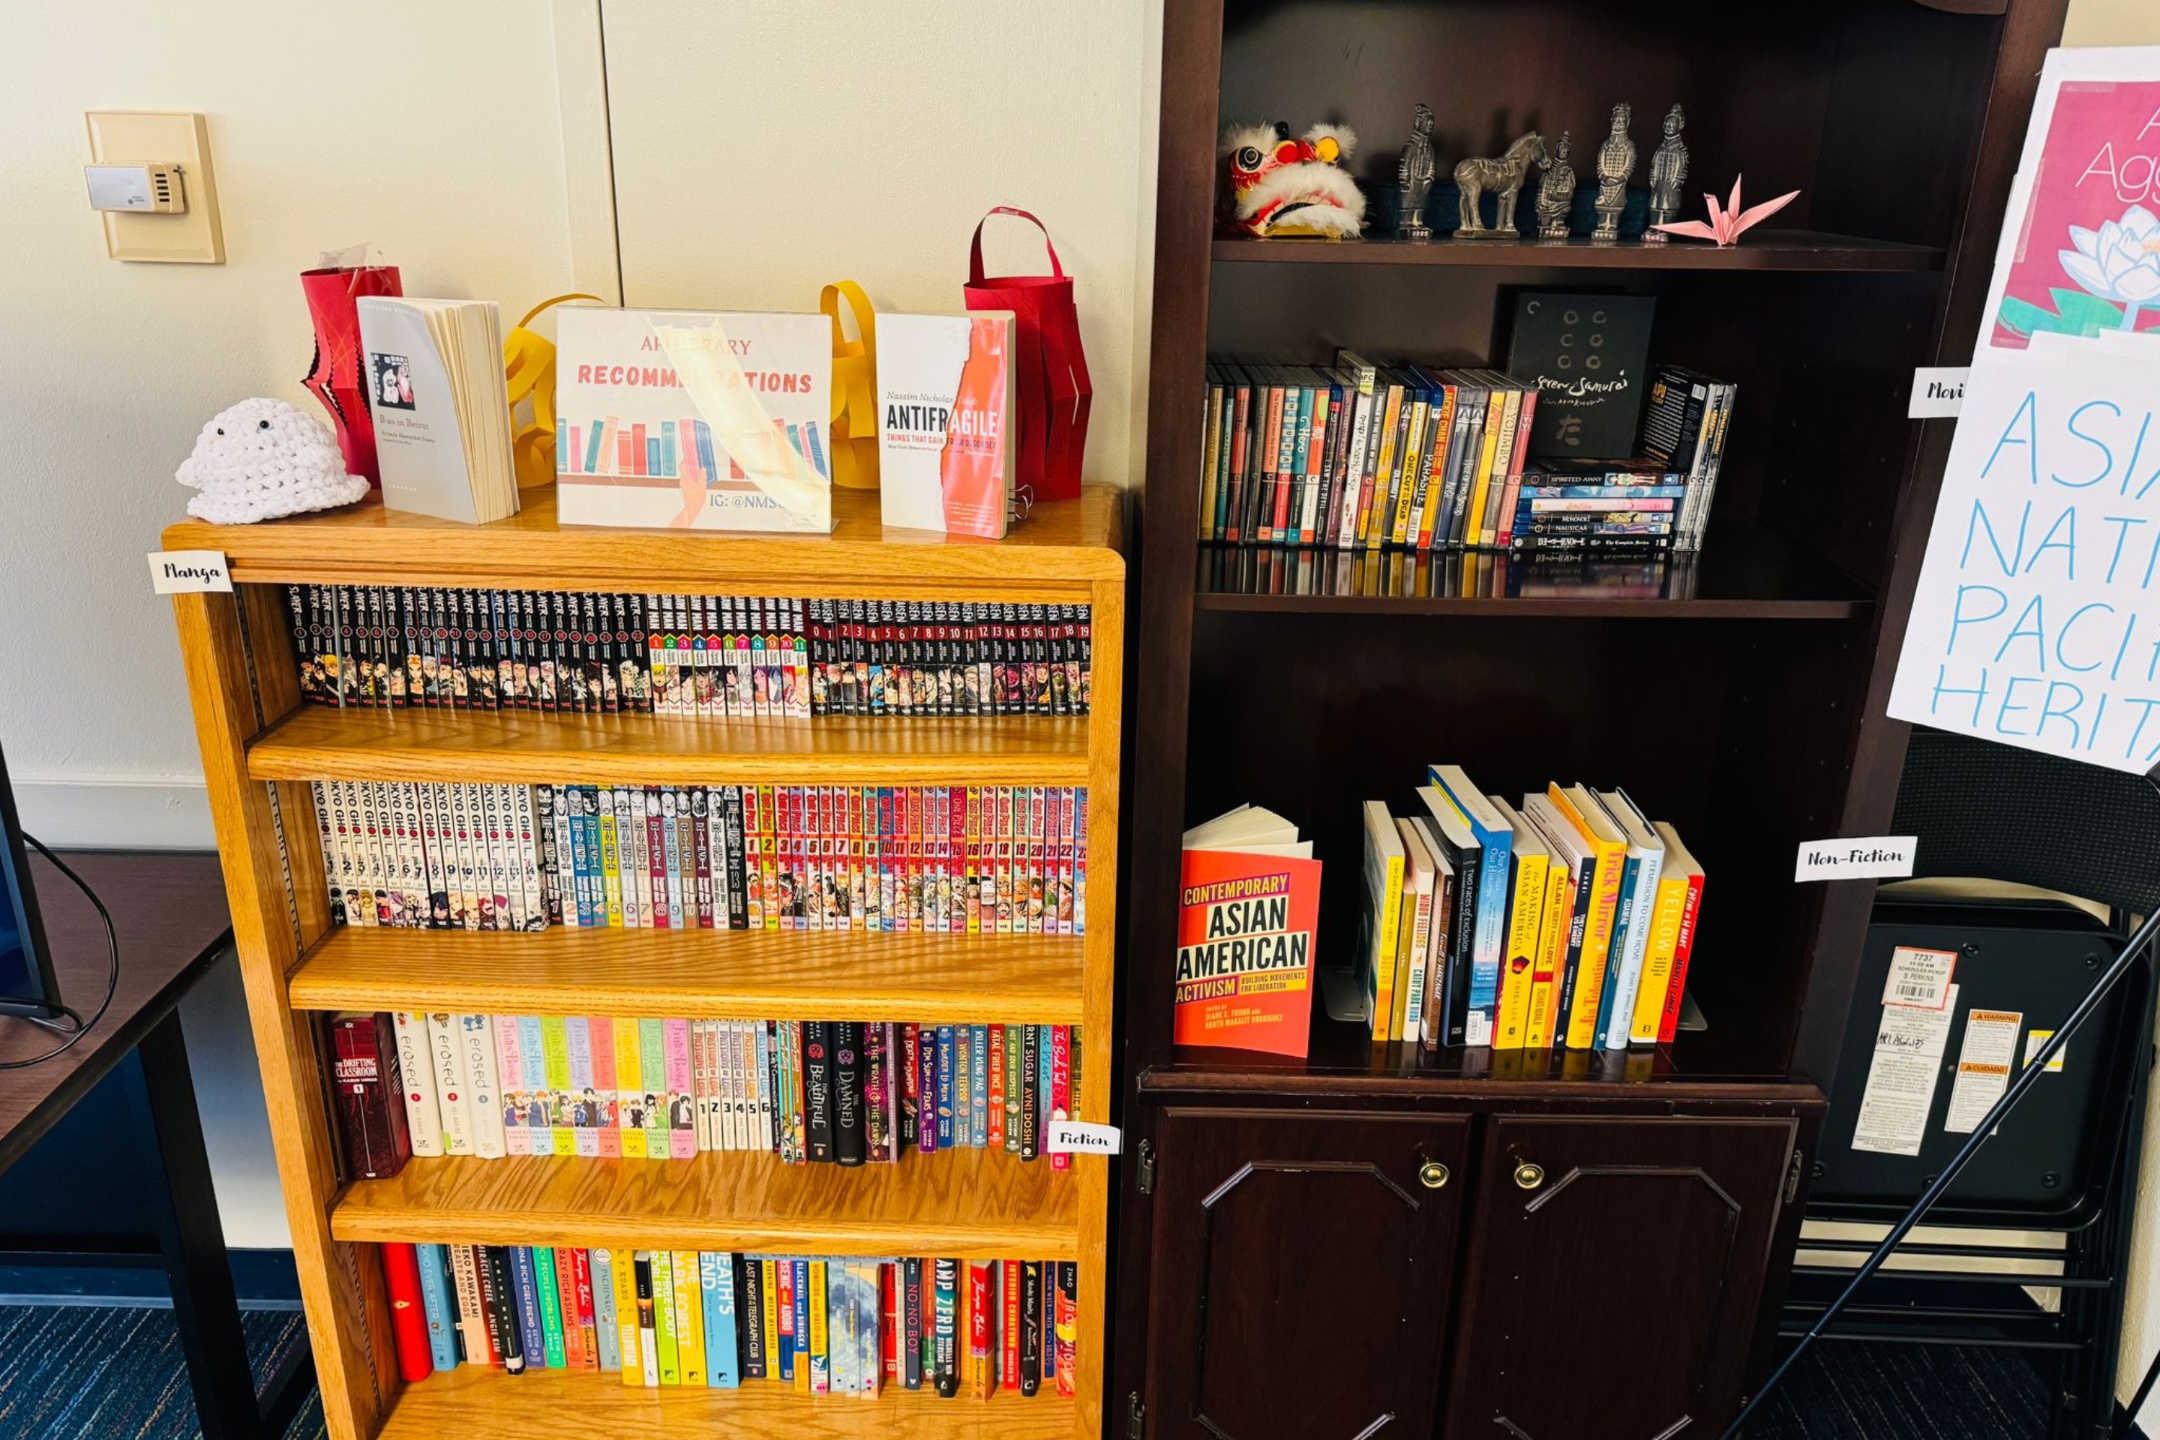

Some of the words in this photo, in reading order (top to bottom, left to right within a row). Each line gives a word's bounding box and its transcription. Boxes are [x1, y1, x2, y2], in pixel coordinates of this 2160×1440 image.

[577, 364, 812, 394] RECOMMATIONS
[1568, 369, 1629, 397] Samurai
[887, 391, 918, 401] Nassim
[919, 393, 954, 403] Nicholas
[1441, 389, 1455, 419] JACKIE
[380, 414, 386, 424] B
[886, 404, 998, 437] ANTIFRAGILE
[887, 433, 911, 443] THINGS
[912, 434, 927, 444] THAT
[928, 435, 944, 445] GAIN
[1298, 427, 1310, 452] Hero
[1437, 419, 1449, 443] CHAN
[1499, 413, 1515, 465] YOJIMBO
[1406, 456, 1416, 474] ONE
[1403, 475, 1414, 491] CUT
[709, 494, 729, 507] IG:
[1399, 500, 1410, 519] DEAD
[164, 563, 221, 584] Manga
[870, 630, 877, 640] 4
[938, 628, 945, 637] 9
[992, 626, 1002, 637] 13
[1050, 628, 1060, 637] 17
[666, 638, 675, 648] 2
[680, 639, 688, 648] 3
[710, 639, 718, 648] 5
[754, 639, 762, 648] 8
[1931, 662, 2160, 761] HERIT
[809, 840, 817, 852] 5
[852, 842, 860, 853] 8
[999, 843, 1008, 855] 18
[1060, 845, 1072, 856] 22
[343, 862, 351, 871] 2
[1604, 849, 1624, 886] Trick
[1808, 849, 1905, 866] Non-Fiction
[388, 865, 396, 874] 5
[447, 864, 455, 874] 9
[730, 871, 740, 888] 13
[1521, 863, 1531, 896] ASIAN
[1183, 874, 1288, 906] CONTEMPORARY
[1642, 860, 1657, 902] PERMISSION
[671, 905, 680, 915] 9
[1208, 896, 1287, 939] ASIAN
[1526, 886, 1539, 930] MAKING
[1550, 907, 1561, 928] LIBERTY
[1595, 892, 1616, 940] Mirror
[1514, 901, 1527, 951] AMERICA
[1636, 916, 1648, 938] COME
[1656, 888, 1681, 951] YELLOW
[1416, 919, 1429, 948] FEELINGS
[1678, 928, 1688, 948] MART
[1176, 932, 1307, 982] AMERICAN
[1546, 946, 1555, 965] LOVE
[1632, 940, 1643, 960] HOME
[1913, 953, 1934, 962] 7737
[1241, 975, 1269, 985] BUILDING
[1270, 972, 1305, 981] MOVEMENTS
[1898, 966, 1927, 974] SCHEDULED
[1927, 968, 1946, 976] PICKUP
[1175, 978, 1236, 1004] ACTIVISM
[1241, 985, 1252, 993] FOR
[1253, 982, 1287, 992] LIBERATION
[1434, 964, 1443, 1000] MANZANAR
[1205, 1010, 1223, 1021] DIANE
[1251, 1014, 1283, 1023] RODRIGUEZ
[1983, 1014, 2017, 1023] WARNING
[974, 1031, 983, 1055] KILLER
[991, 1030, 1001, 1050] FATAL
[342, 1058, 376, 1067] DRIFTING
[959, 1044, 968, 1073] WONTON
[1024, 1050, 1033, 1082] SUGAR
[1972, 1064, 2006, 1074] CUIDADO
[336, 1066, 378, 1077] CLASSROOM
[871, 1063, 880, 1090] WRATH
[811, 1064, 826, 1129] BEAUTIFUL
[959, 1076, 968, 1101] TERROR
[712, 1103, 719, 1112] 2
[736, 1104, 744, 1113] 4
[840, 1072, 854, 1128] DAMNED
[1023, 1114, 1032, 1144] DOSHI
[1059, 1132, 1112, 1147] Fiction
[521, 1265, 531, 1283] RICH
[701, 1252, 716, 1290] END
[747, 1262, 755, 1278] LAST
[797, 1262, 805, 1299] BLACKMAIL
[483, 1279, 493, 1302] CREEK
[747, 1279, 756, 1301] NIGHT
[1008, 1265, 1017, 1301] INTERIOR
[466, 1270, 479, 1318] KAWAKAMI
[428, 1294, 439, 1318] AFTER
[461, 1297, 470, 1318] EGGS
[522, 1285, 535, 1327] GIRLFRIEND
[564, 1297, 574, 1327] ASIANS
[663, 1271, 675, 1339] THREE-BODY
[908, 1284, 918, 1326] NO-NO
[936, 1296, 952, 1334] ZERO
[488, 1313, 498, 1336] ANGIE
[674, 1293, 690, 1347] FOREST
[748, 1306, 758, 1341] TELEGRAPH
[782, 1304, 792, 1330] ADOBO
[1008, 1304, 1016, 1348] CHINATOWN
[492, 1338, 500, 1352] KIM
[750, 1343, 759, 1358] CLUB
[908, 1330, 918, 1354] BOY
